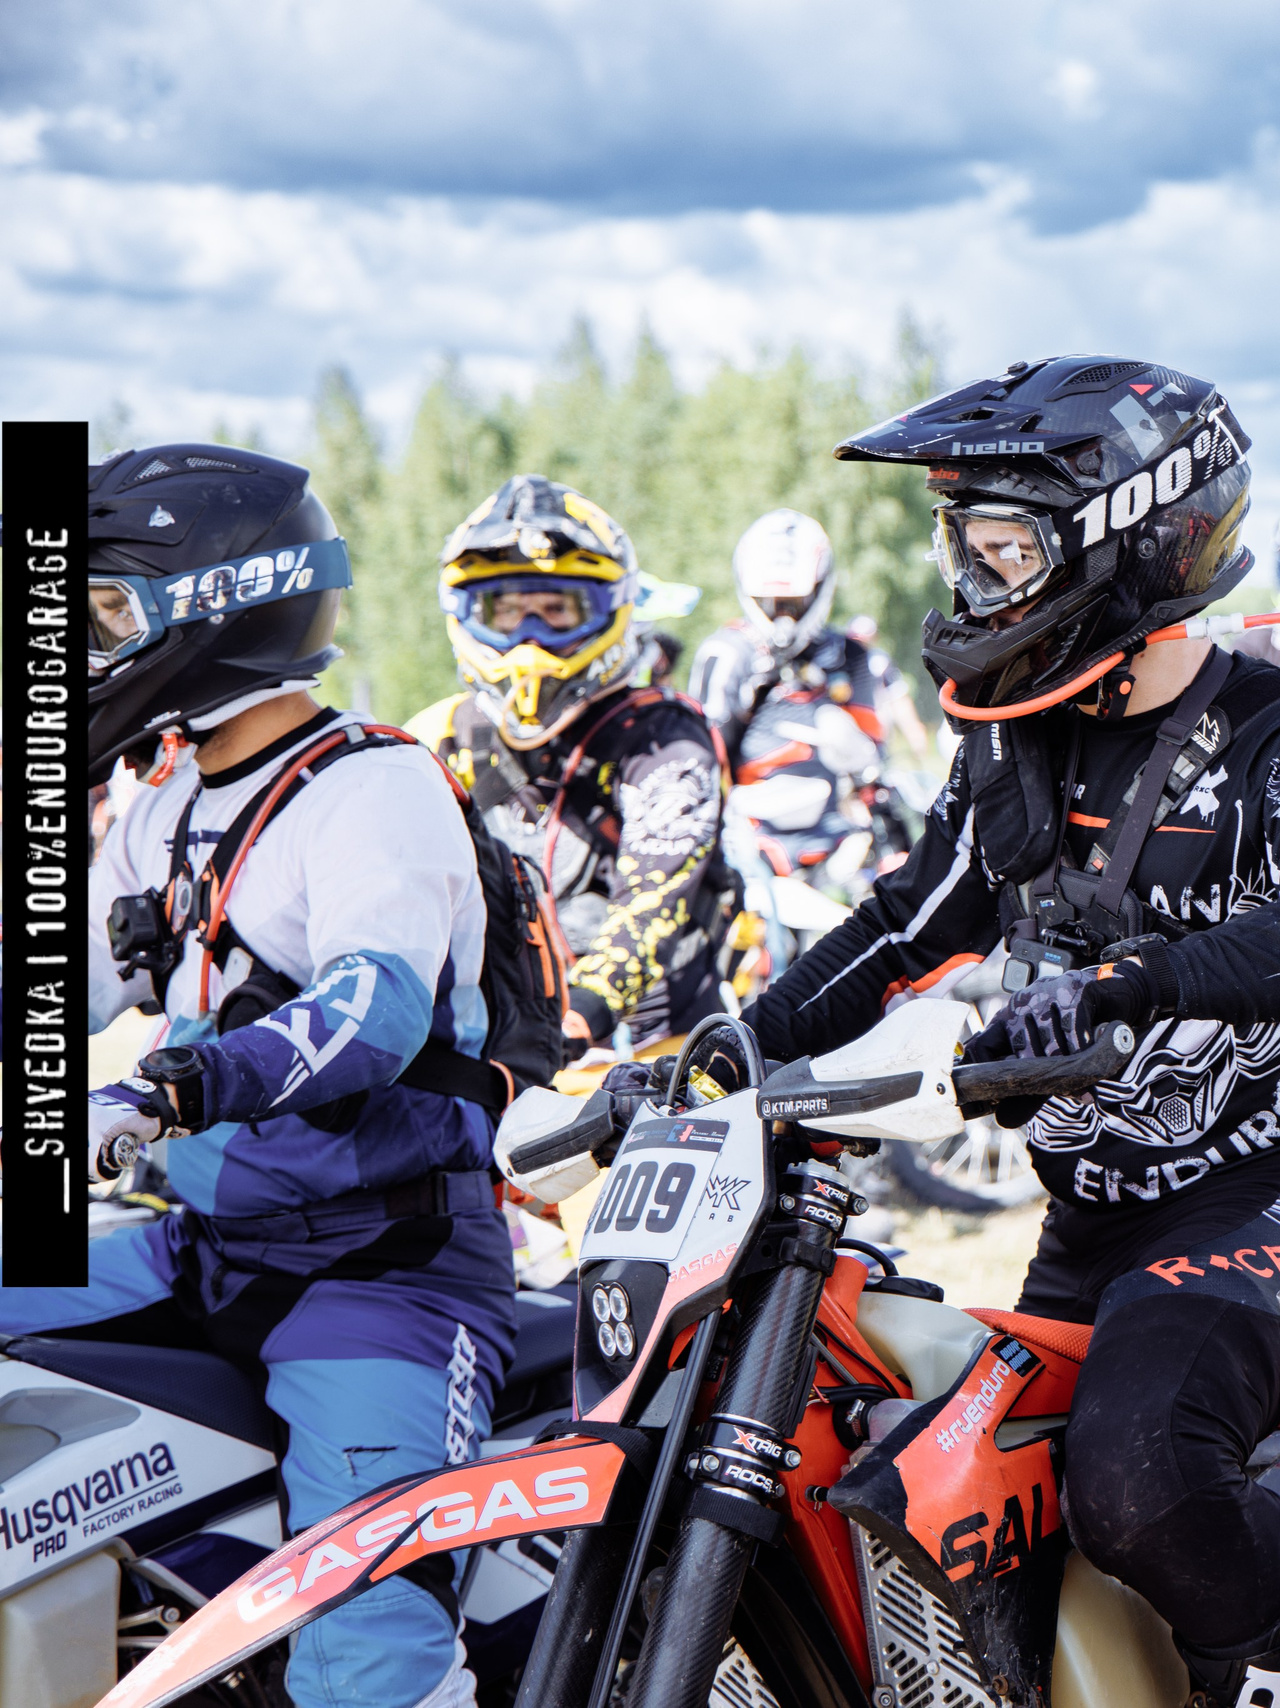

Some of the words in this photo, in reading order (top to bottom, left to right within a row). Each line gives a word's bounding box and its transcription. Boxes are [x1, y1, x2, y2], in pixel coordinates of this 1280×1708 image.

[951, 440, 1045, 456] hebo
[1073, 422, 1243, 549] 100%
[165, 547, 315, 621] 100%
[593, 1161, 696, 1234] 009
[813, 1179, 849, 1202] XTRIG
[935, 1359, 1011, 1453] #ruenduro
[731, 1425, 783, 1458] XTRIG
[82, 1503, 135, 1538] FACTORY
[137, 1482, 183, 1513] RACING
[33, 1529, 67, 1563] PRO
[236, 1465, 590, 1623] GASGAS
